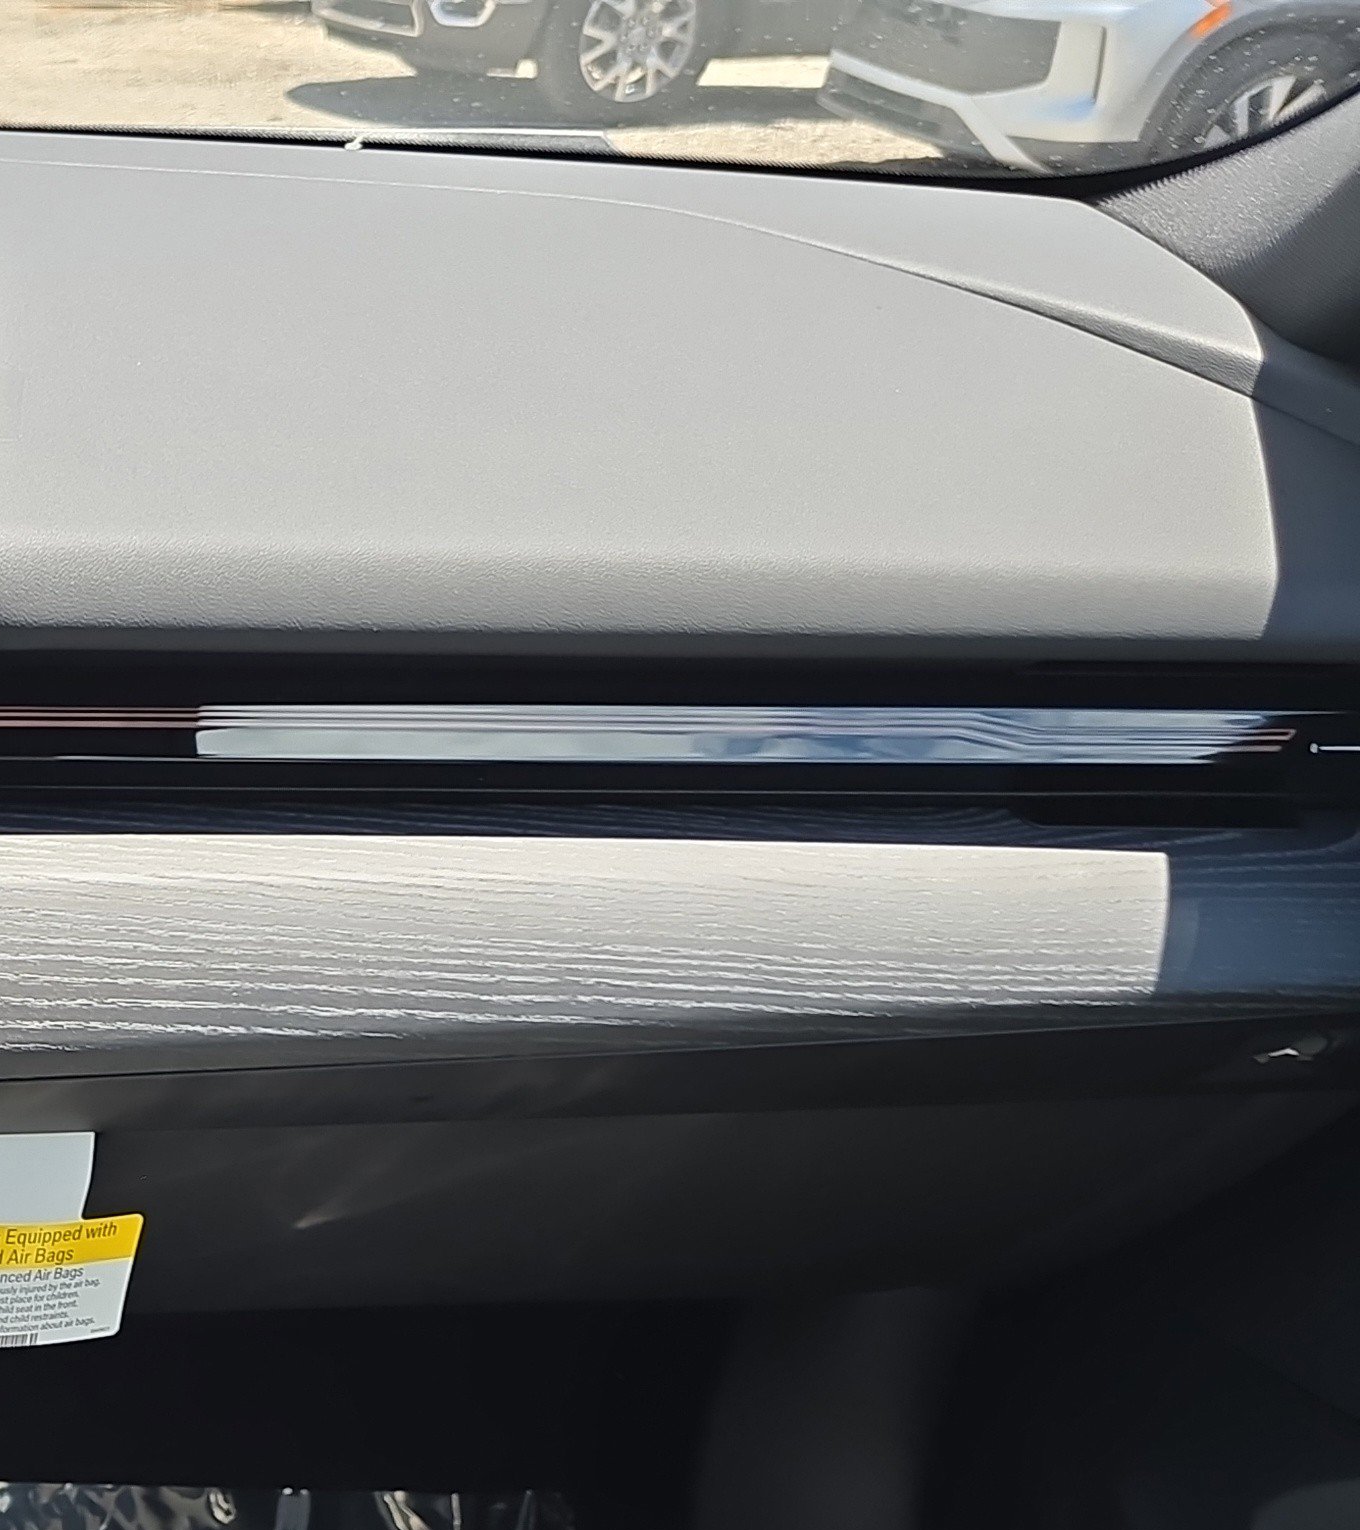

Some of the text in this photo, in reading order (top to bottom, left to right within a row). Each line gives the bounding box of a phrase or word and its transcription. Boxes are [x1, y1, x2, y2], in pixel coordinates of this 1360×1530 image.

[6, 1226, 83, 1248] Equipped
[86, 1222, 117, 1239] with
[6, 1249, 31, 1265] Air
[34, 1248, 74, 1266] Bags
[33, 1269, 53, 1281] Air
[53, 1267, 84, 1281] Bags
[18, 1284, 48, 1295] injured
[48, 1283, 58, 1294] by
[16, 1304, 33, 1313] seat
[34, 1303, 41, 1312] in
[42, 1302, 56, 1311] the
[9, 1314, 30, 1323] child
